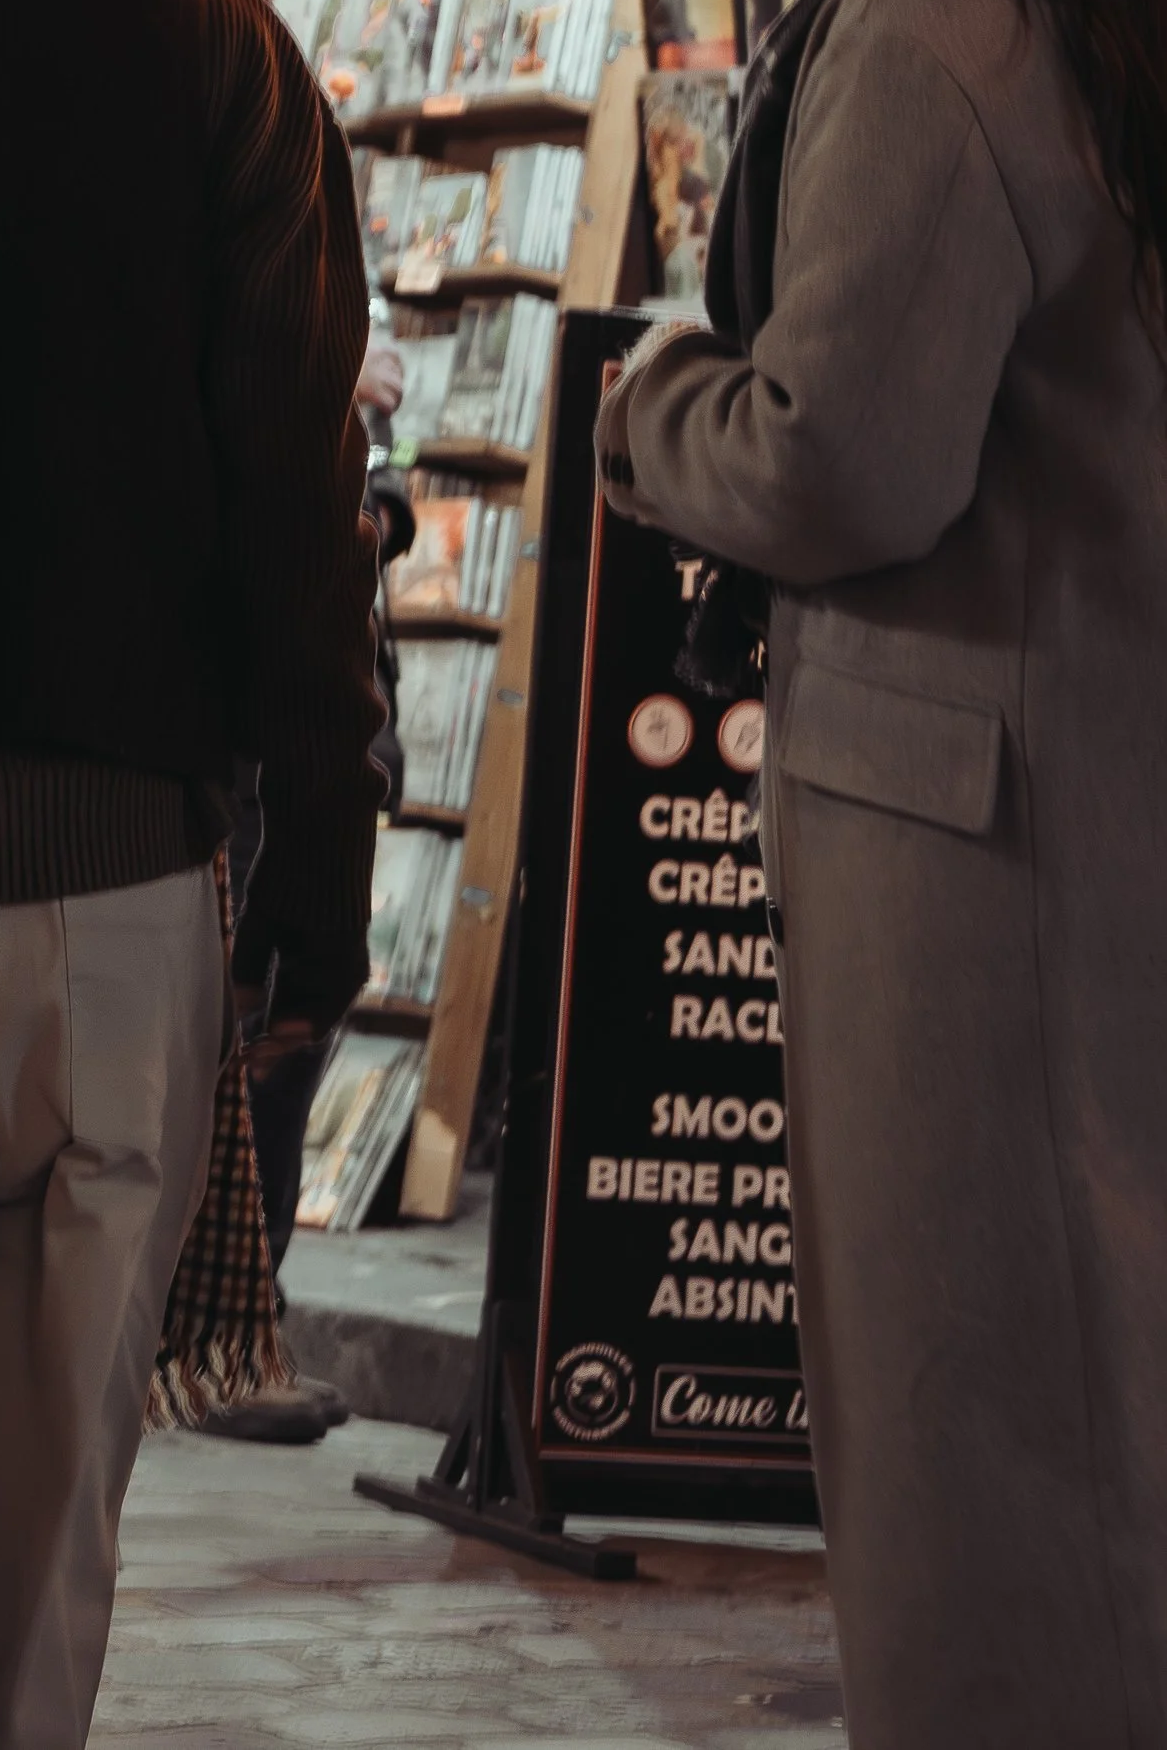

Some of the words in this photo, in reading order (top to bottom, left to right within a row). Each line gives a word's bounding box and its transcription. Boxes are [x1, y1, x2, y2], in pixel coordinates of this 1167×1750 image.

[647, 851, 766, 909] CRÊP
[650, 1092, 785, 1143] SMOO
[586, 1155, 720, 1206] BIERE
[732, 1164, 791, 1211] PR
[668, 1217, 791, 1266] SANG
[660, 1373, 777, 1429] Come
